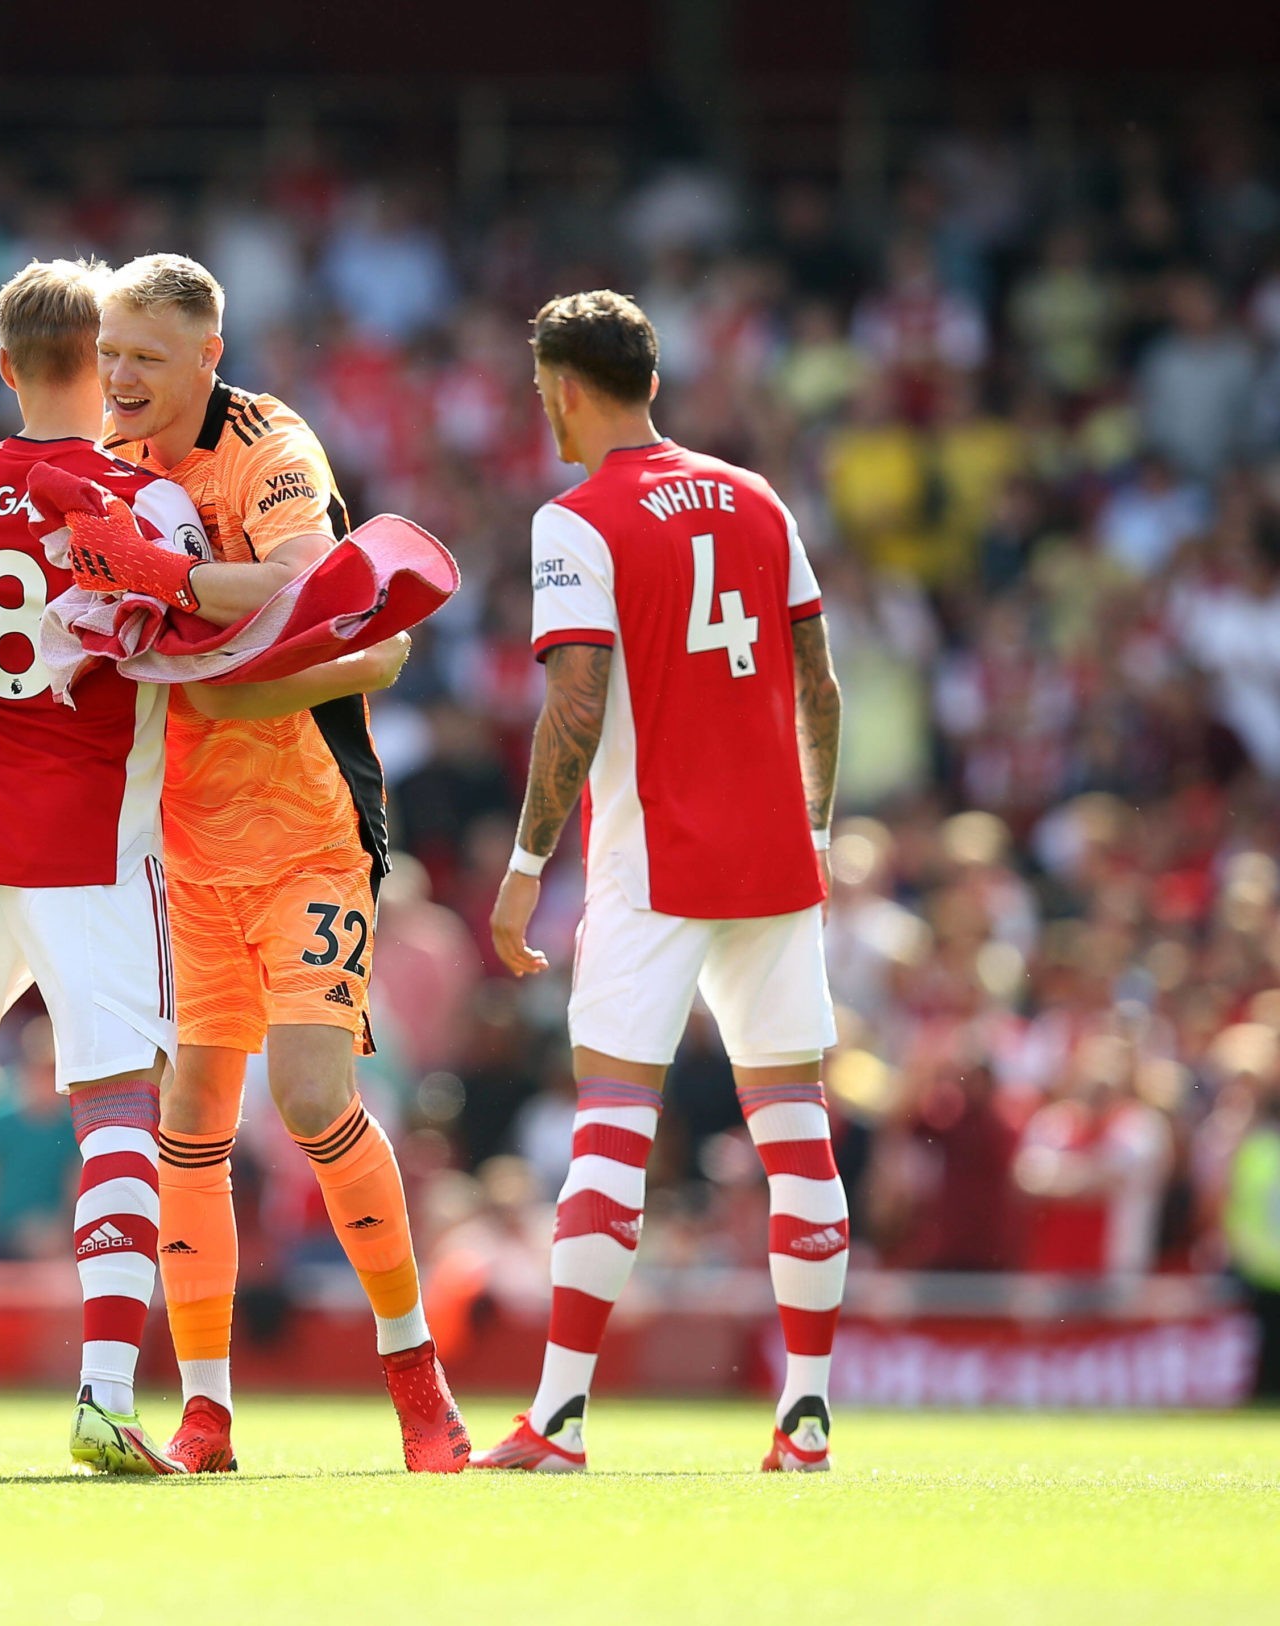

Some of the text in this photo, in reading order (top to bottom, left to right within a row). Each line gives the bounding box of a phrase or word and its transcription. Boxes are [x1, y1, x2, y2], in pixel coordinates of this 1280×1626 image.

[265, 472, 307, 490] VISIT
[257, 485, 318, 514] RWAND
[639, 479, 736, 522] WHITE
[686, 533, 759, 679] 4
[302, 902, 368, 978] 32
[324, 992, 354, 1008] adidas
[76, 1237, 133, 1255] adidas
